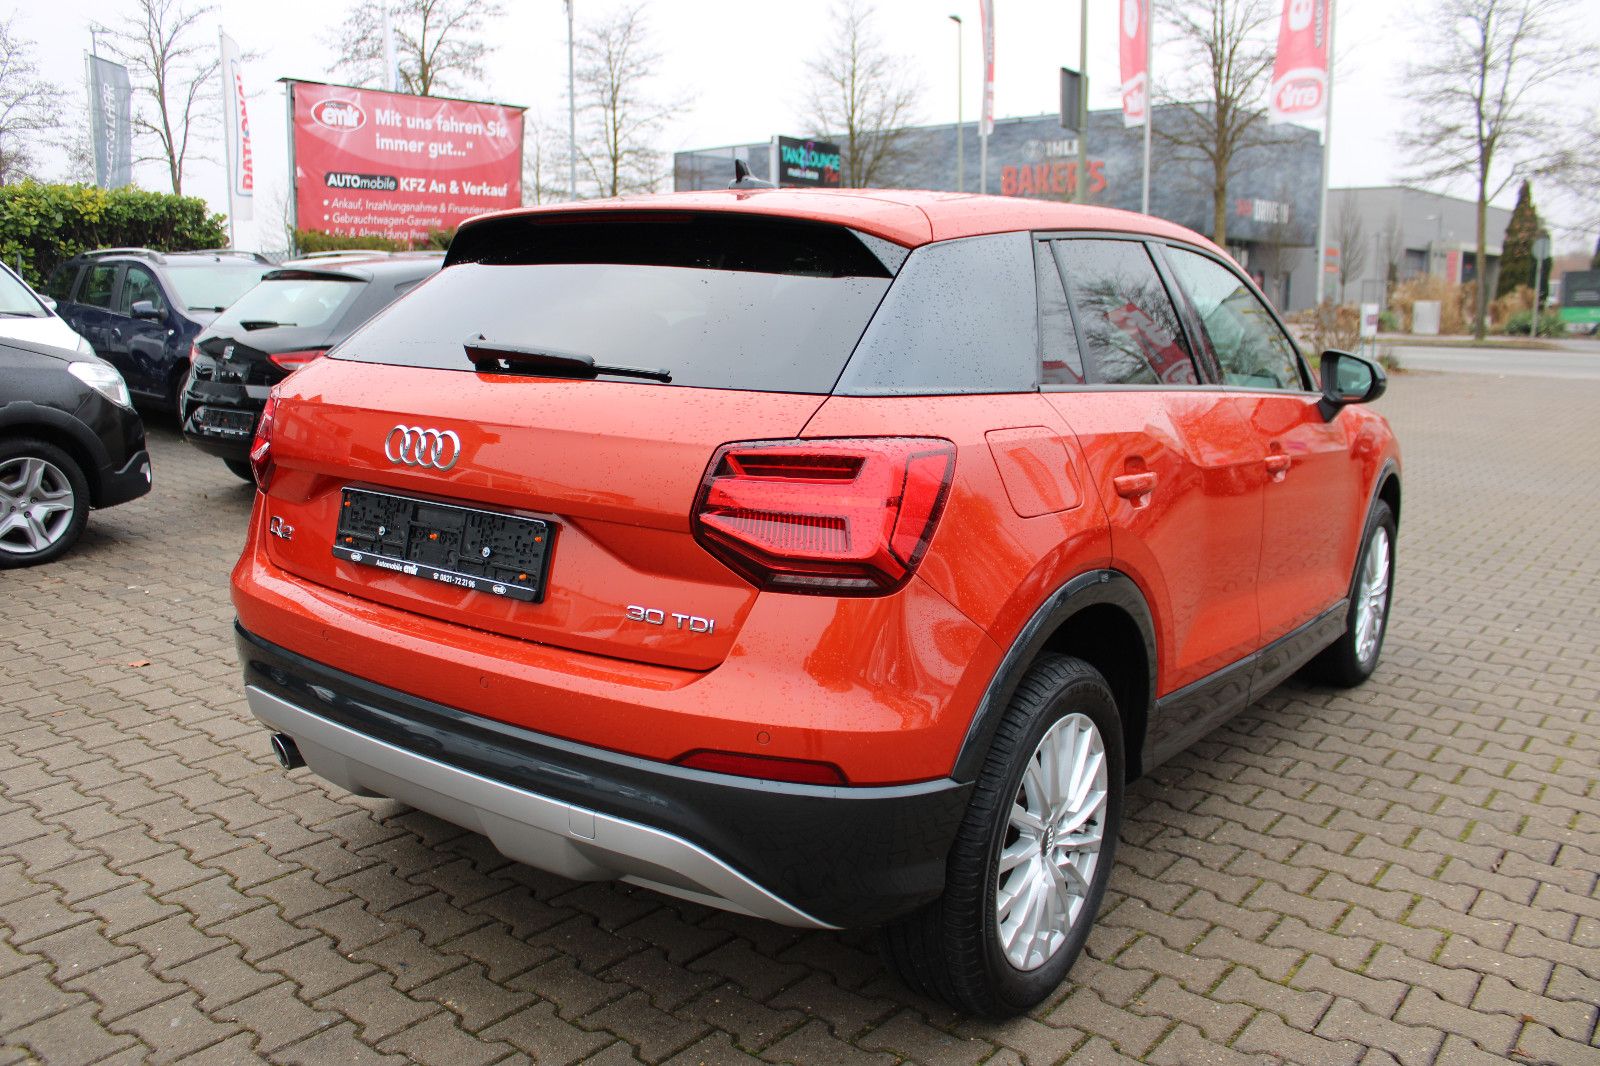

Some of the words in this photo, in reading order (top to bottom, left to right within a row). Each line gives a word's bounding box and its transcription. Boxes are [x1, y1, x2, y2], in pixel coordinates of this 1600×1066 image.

[374, 108, 402, 127] Mit
[406, 116, 433, 131] uns
[436, 114, 483, 136] fahren
[487, 120, 508, 138] Sie
[375, 132, 424, 153] immer
[327, 173, 396, 190] AUTOmobile
[400, 177, 426, 192] KFZ
[429, 180, 446, 194] An
[449, 180, 459, 195] &
[462, 181, 508, 197] Verkauf
[271, 516, 295, 540] Q2
[376, 559, 403, 571] Automobile
[403, 564, 419, 575] emir
[625, 605, 665, 626] 30
[671, 612, 716, 635] TDI
